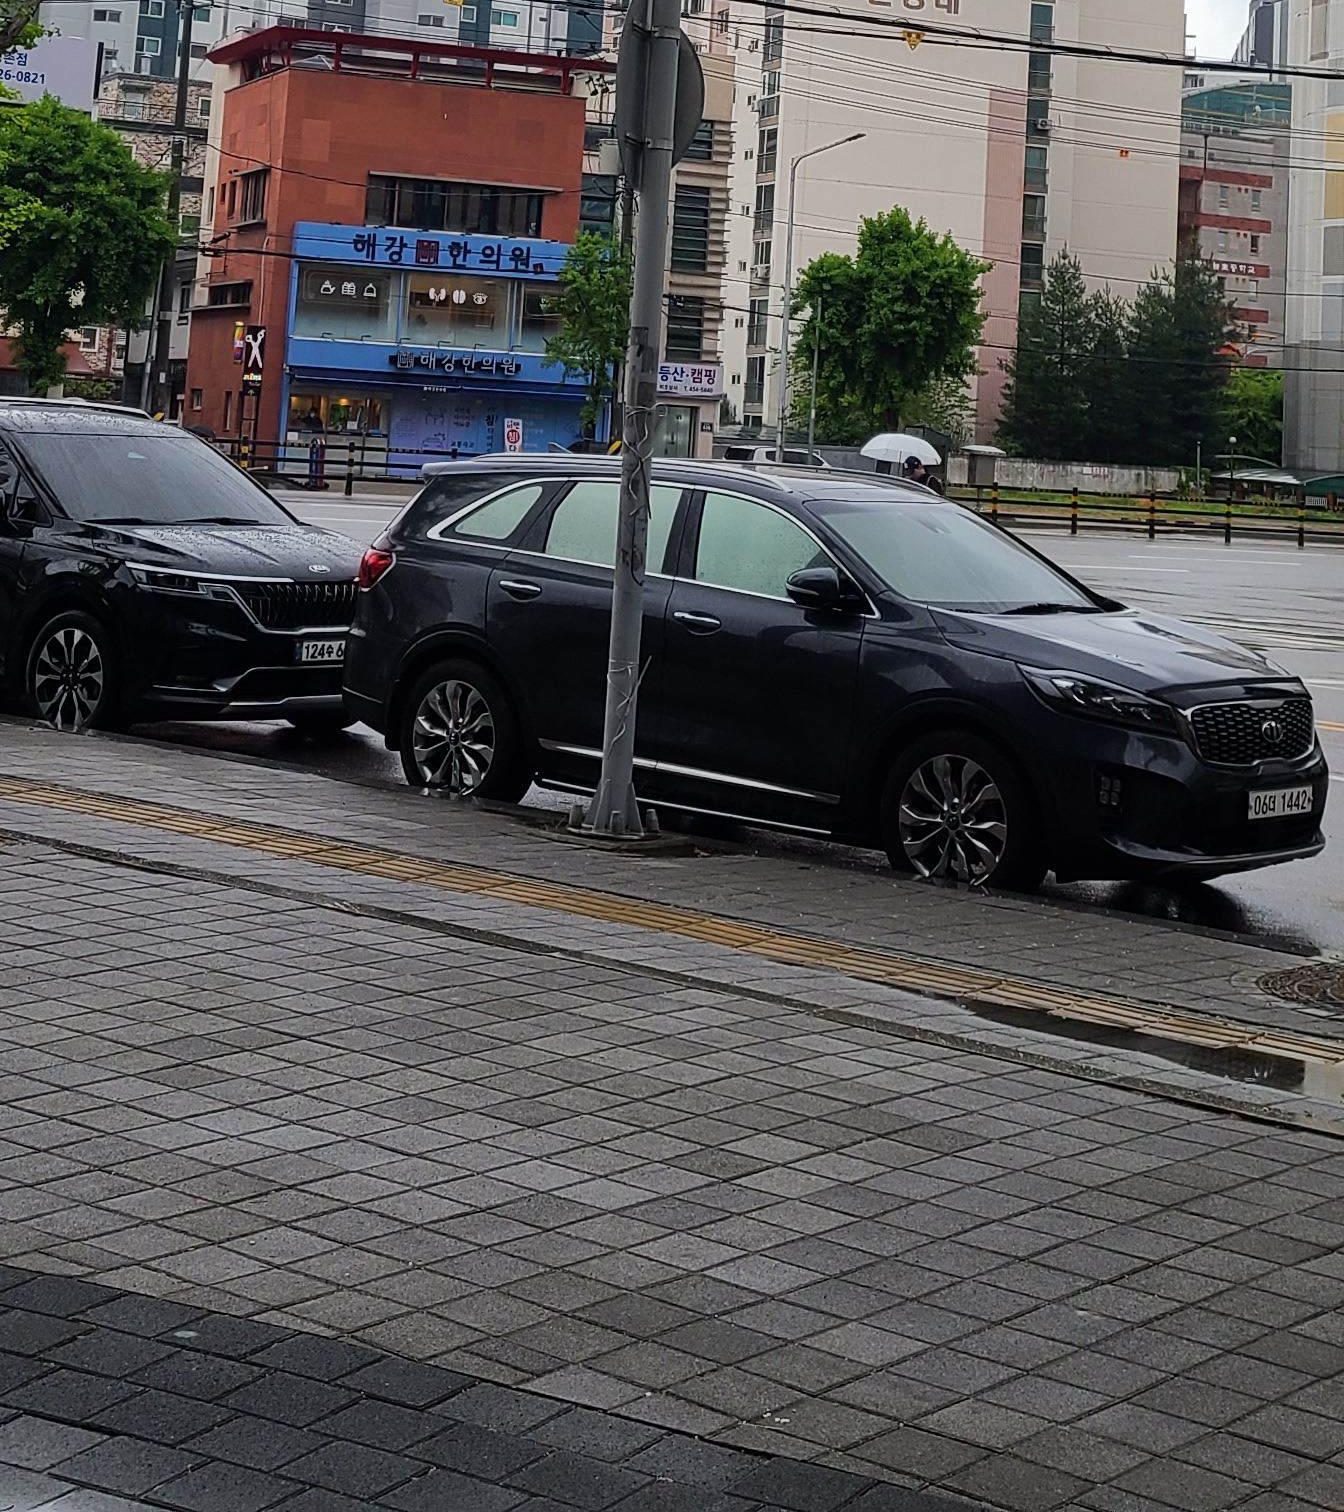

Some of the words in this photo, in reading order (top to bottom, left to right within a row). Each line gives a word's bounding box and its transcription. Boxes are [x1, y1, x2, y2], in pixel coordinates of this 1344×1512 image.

[353, 233, 408, 263] 해강
[448, 241, 531, 270] 한의원
[419, 351, 518, 376] 해강한의원
[1281, 789, 1308, 813] 1442
